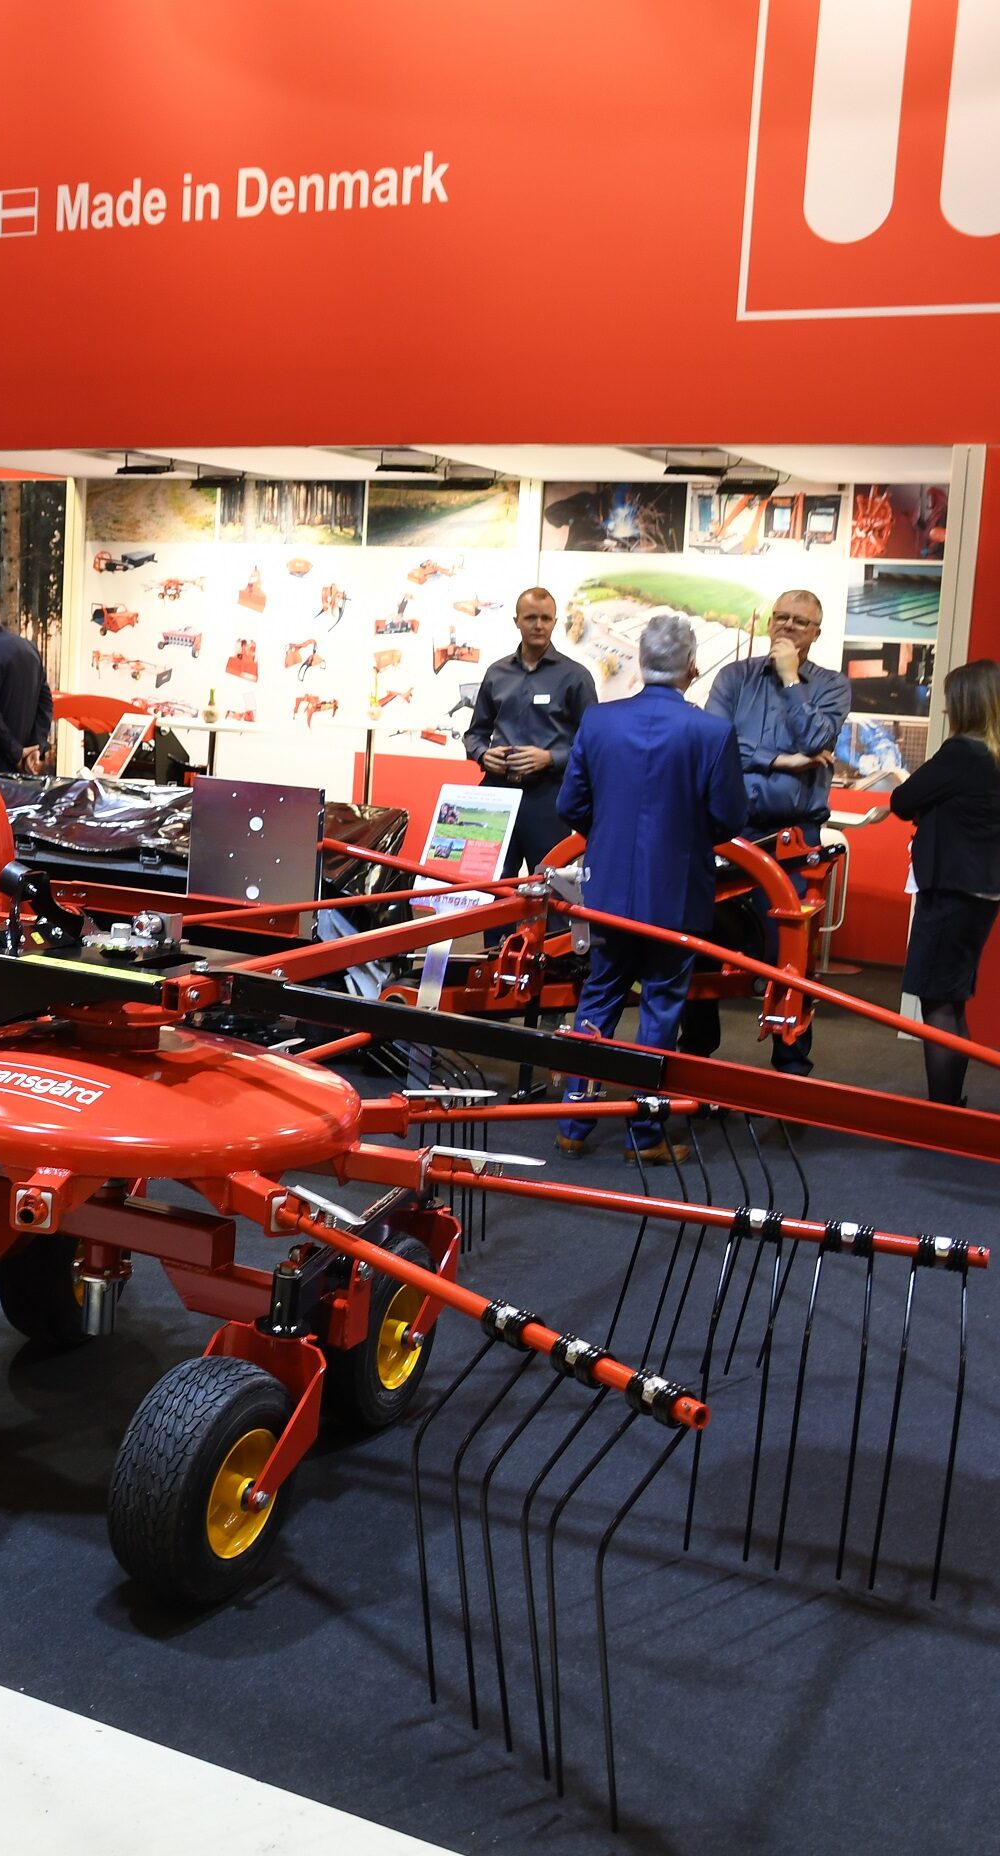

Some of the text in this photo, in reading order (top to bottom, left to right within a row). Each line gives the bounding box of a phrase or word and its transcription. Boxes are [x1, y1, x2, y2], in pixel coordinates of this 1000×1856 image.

[56, 151, 449, 231] Made in Denmark
